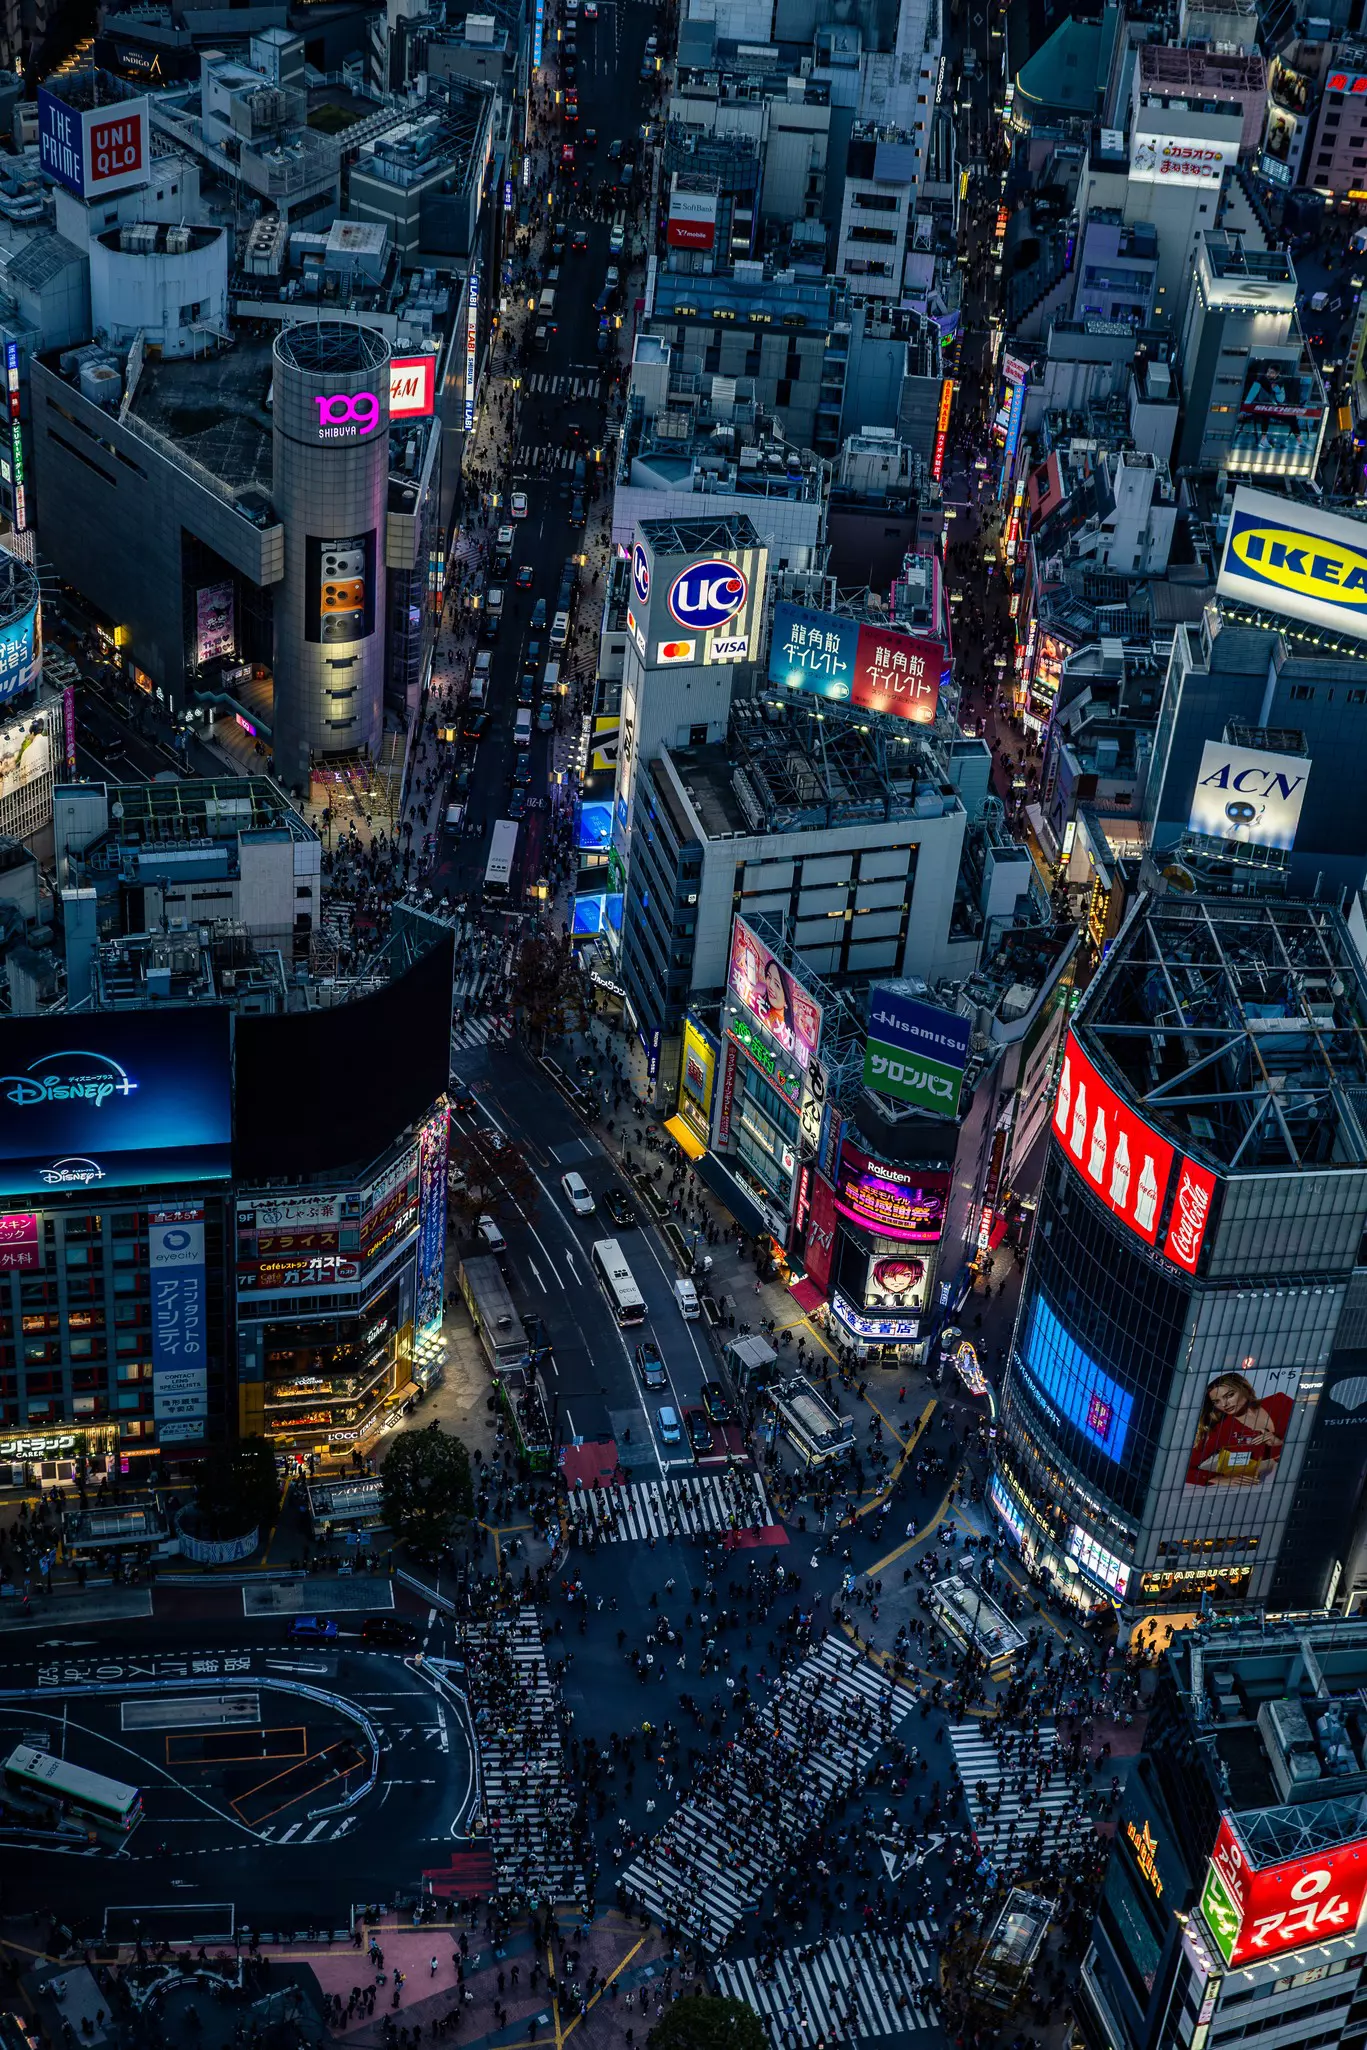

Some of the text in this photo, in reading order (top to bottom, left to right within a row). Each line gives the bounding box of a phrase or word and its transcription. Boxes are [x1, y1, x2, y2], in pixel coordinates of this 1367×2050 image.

[123, 55, 149, 67] INDIGO
[49, 105, 72, 147] THE
[96, 124, 133, 150] UNI
[43, 132, 81, 184] PRIME
[97, 146, 139, 174] QLO
[1171, 146, 1215, 162] カラオケ
[1160, 159, 1213, 178] まねきねこ
[682, 202, 714, 213] SoftBank
[470, 277, 479, 307] LABI
[467, 324, 476, 352] LABI
[315, 392, 379, 435] 109
[465, 400, 474, 430] LABI
[319, 427, 356, 438] SHIBUYA
[321, 540, 365, 552] PRO
[1246, 535, 1367, 594] IKEA
[714, 640, 747, 653] VISA
[791, 623, 841, 656] 龍角散
[875, 645, 926, 679] 龍角散
[1199, 764, 1305, 800] ACN
[872, 1011, 966, 1051] Hisamitsu
[68, 1075, 113, 1083] ディズニープラス
[871, 1054, 954, 1101] サロンパス
[0, 1076, 137, 1107] Disney+
[40, 1169, 106, 1184] Disney+
[868, 1161, 911, 1183] Rakuten
[845, 1181, 931, 1222] 最強感謝祭
[863, 1184, 911, 1205] 楽天モバイル
[239, 1213, 255, 1223] 9F
[284, 1205, 334, 1219] しゃぶ葉
[395, 1207, 416, 1232] ガスト
[259, 1232, 337, 1250] プライス
[2, 1252, 32, 1266] 外科
[156, 1251, 199, 1263] eyecity
[310, 1257, 348, 1269] ガスト
[239, 1275, 257, 1285] 7F
[284, 1268, 331, 1285] ガスト
[157, 1280, 180, 1355] アイシティ
[184, 1279, 200, 1353] コンタクトの
[1002, 1463, 1056, 1540] STARBUCKS
[1151, 1566, 1251, 1581] STARBUCKS
[1080, 1574, 1108, 1600] TSUTAYA
[1251, 1895, 1349, 1946] アコム
